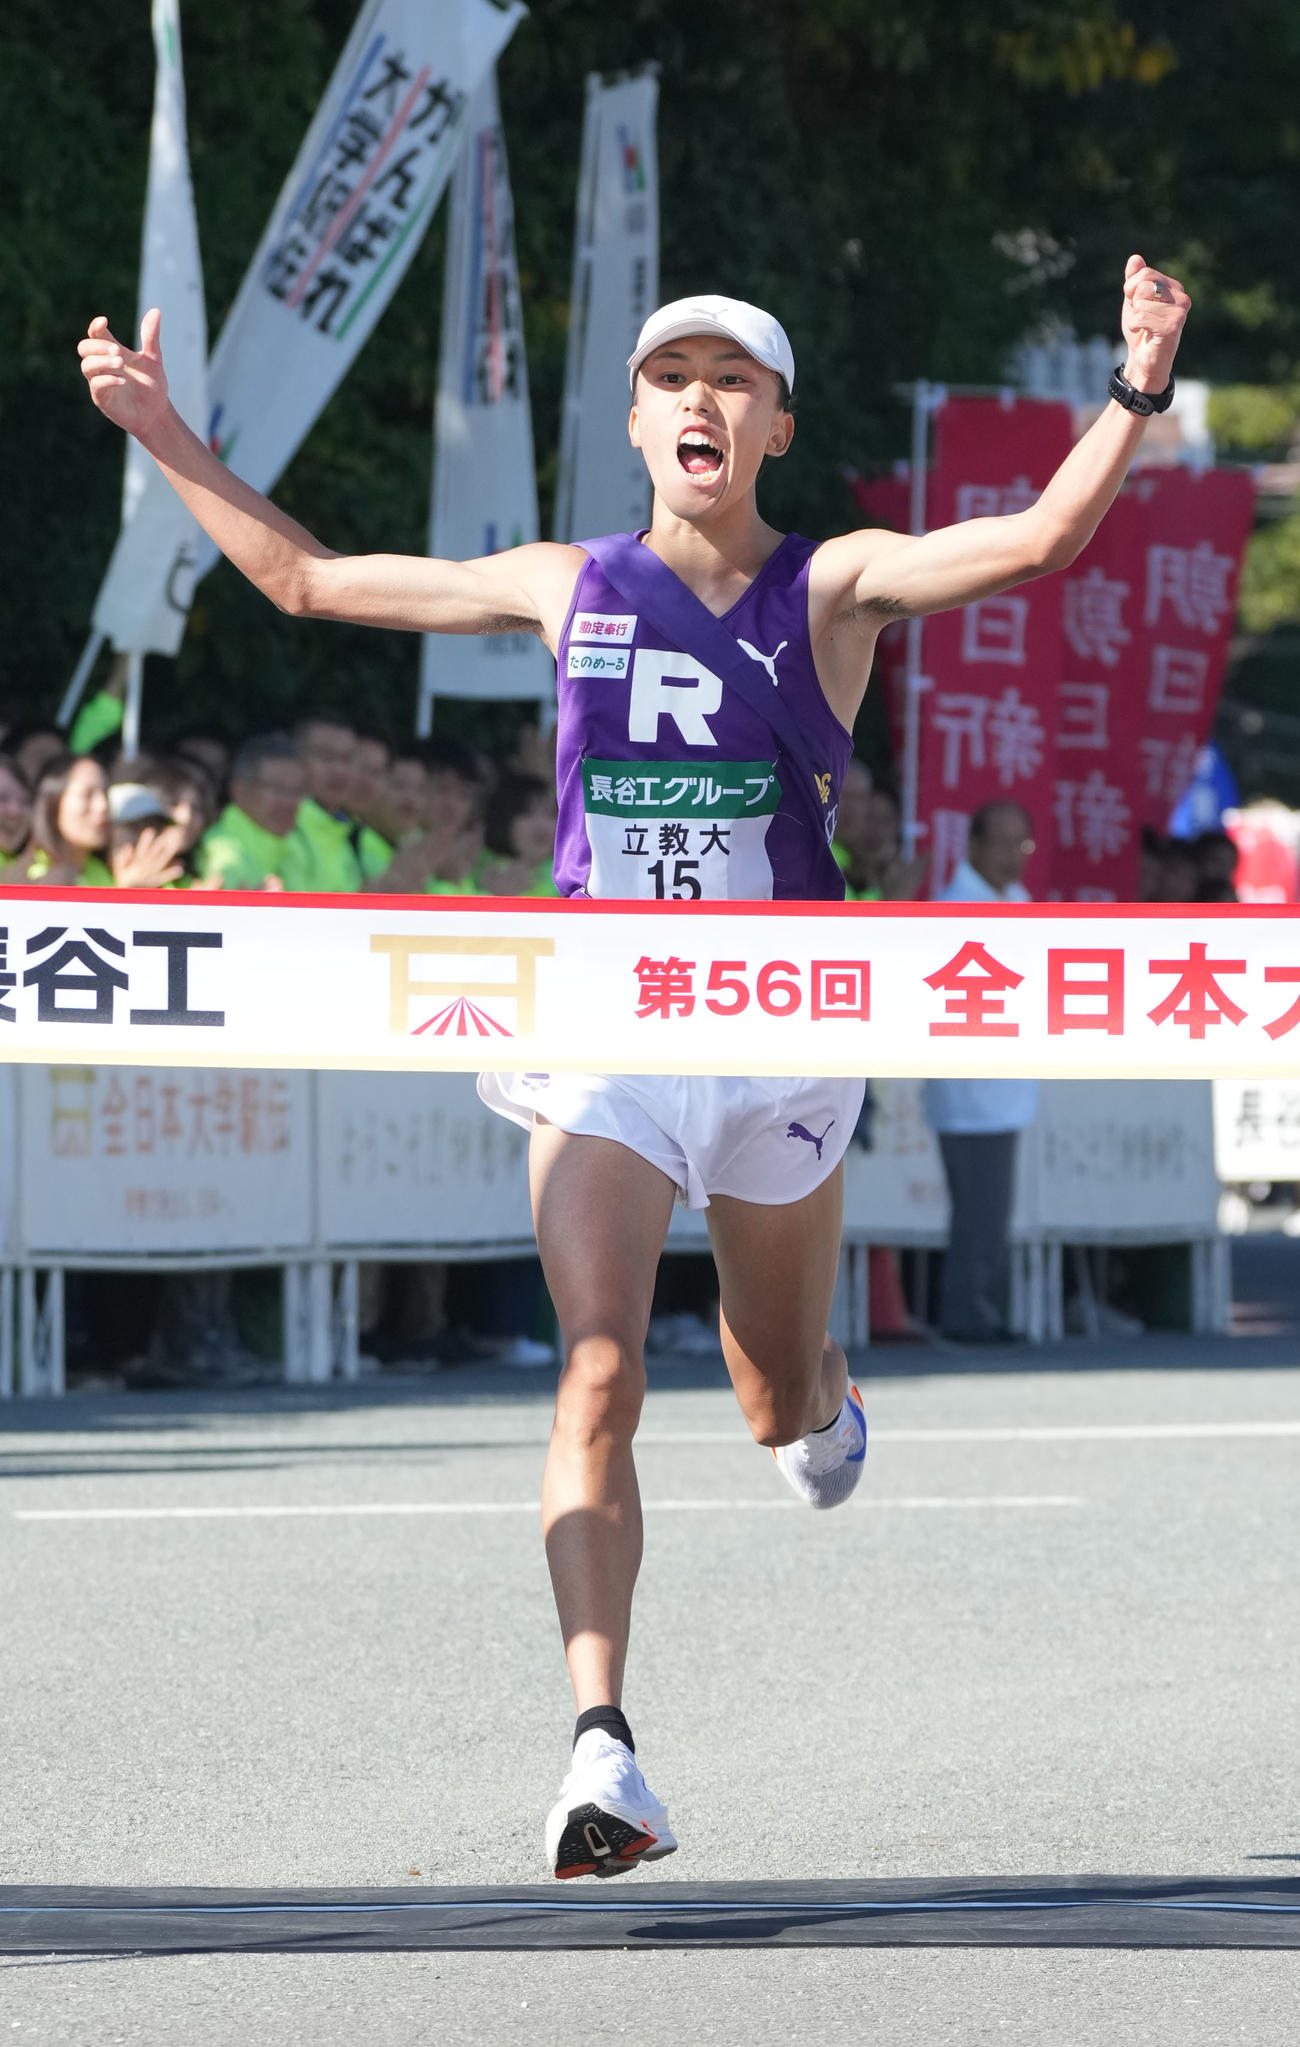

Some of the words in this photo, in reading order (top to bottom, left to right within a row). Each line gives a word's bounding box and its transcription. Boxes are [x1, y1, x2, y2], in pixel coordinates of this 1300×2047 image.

[579, 620, 628, 636] 勘定奉行
[570, 656, 625, 671] たのめーる
[629, 648, 723, 746] R
[590, 774, 775, 807] 長谷工グループ
[621, 823, 731, 856] 立教大
[647, 860, 702, 899] 15
[0, 926, 225, 1027] 谷工
[632, 955, 871, 1022] 第56回
